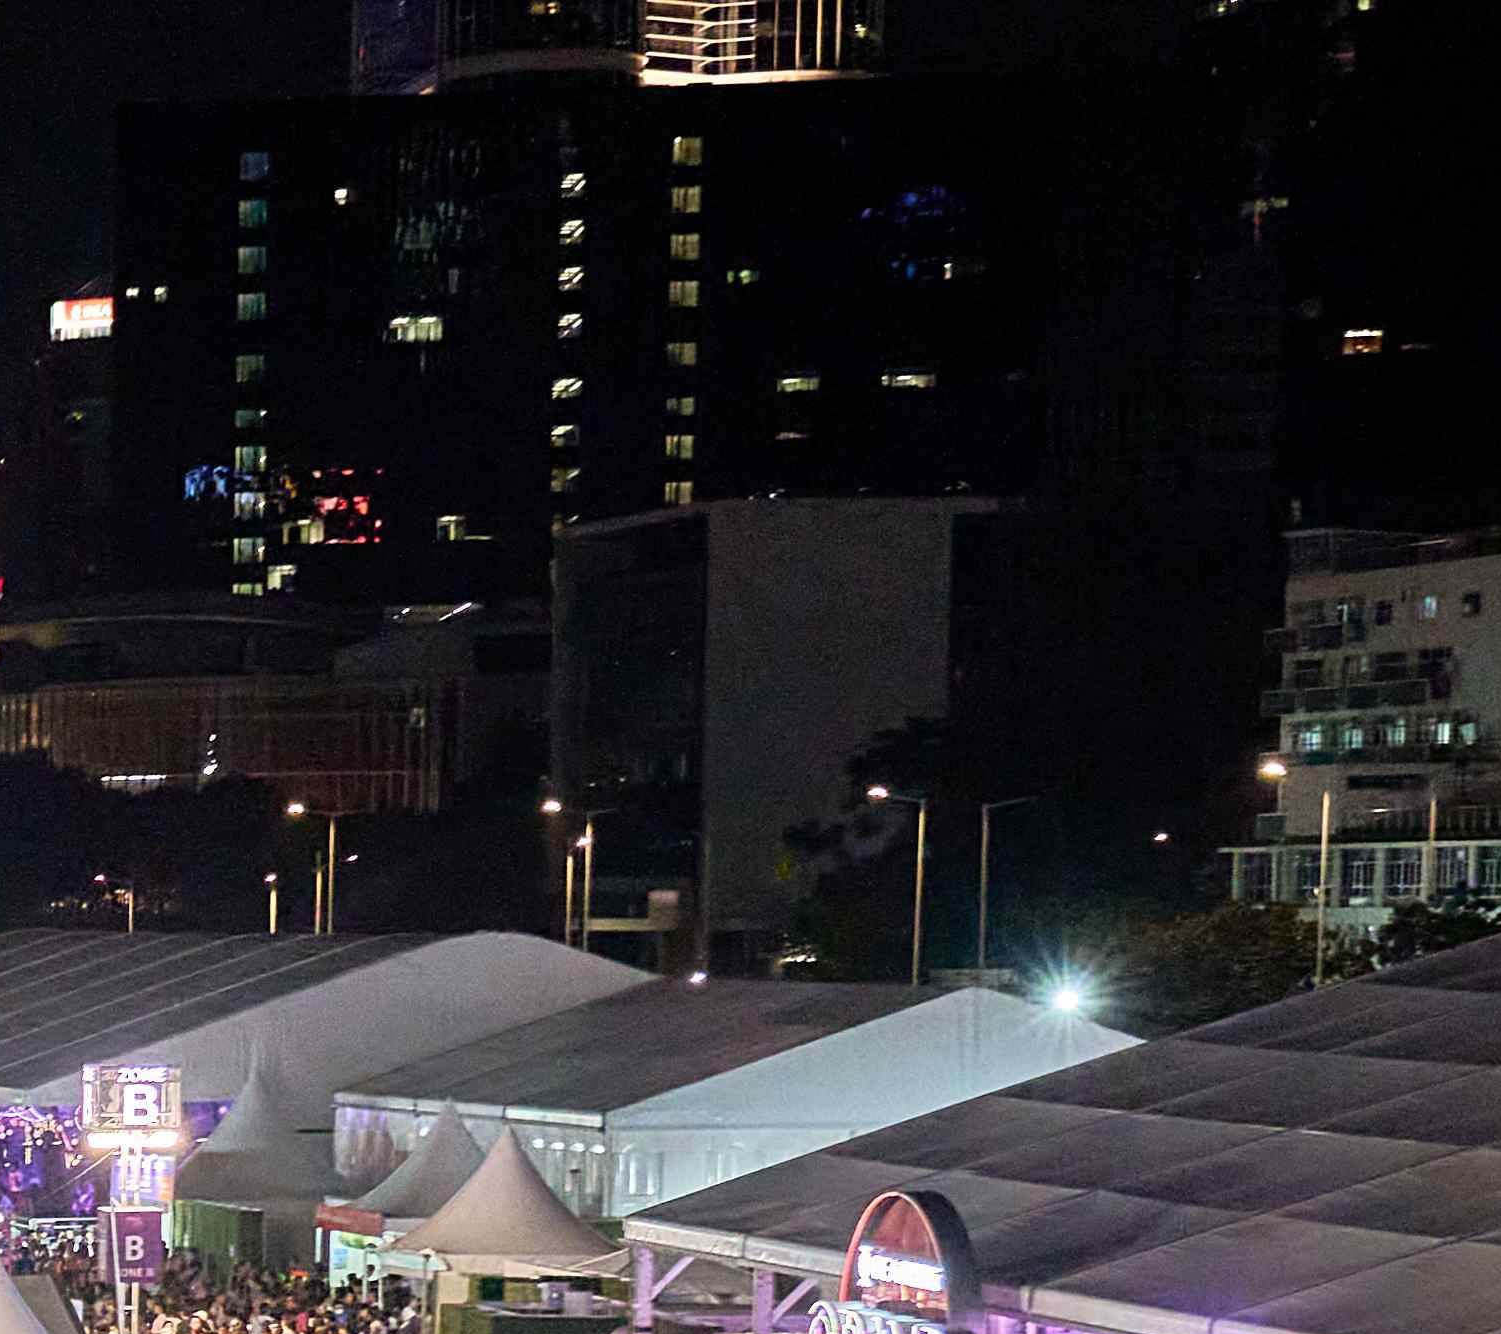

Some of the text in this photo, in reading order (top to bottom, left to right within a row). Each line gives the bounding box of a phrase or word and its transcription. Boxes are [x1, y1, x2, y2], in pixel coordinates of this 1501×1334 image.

[117, 1067, 169, 1082] ZONE
[123, 1083, 159, 1126] B
[125, 1235, 144, 1261] B
